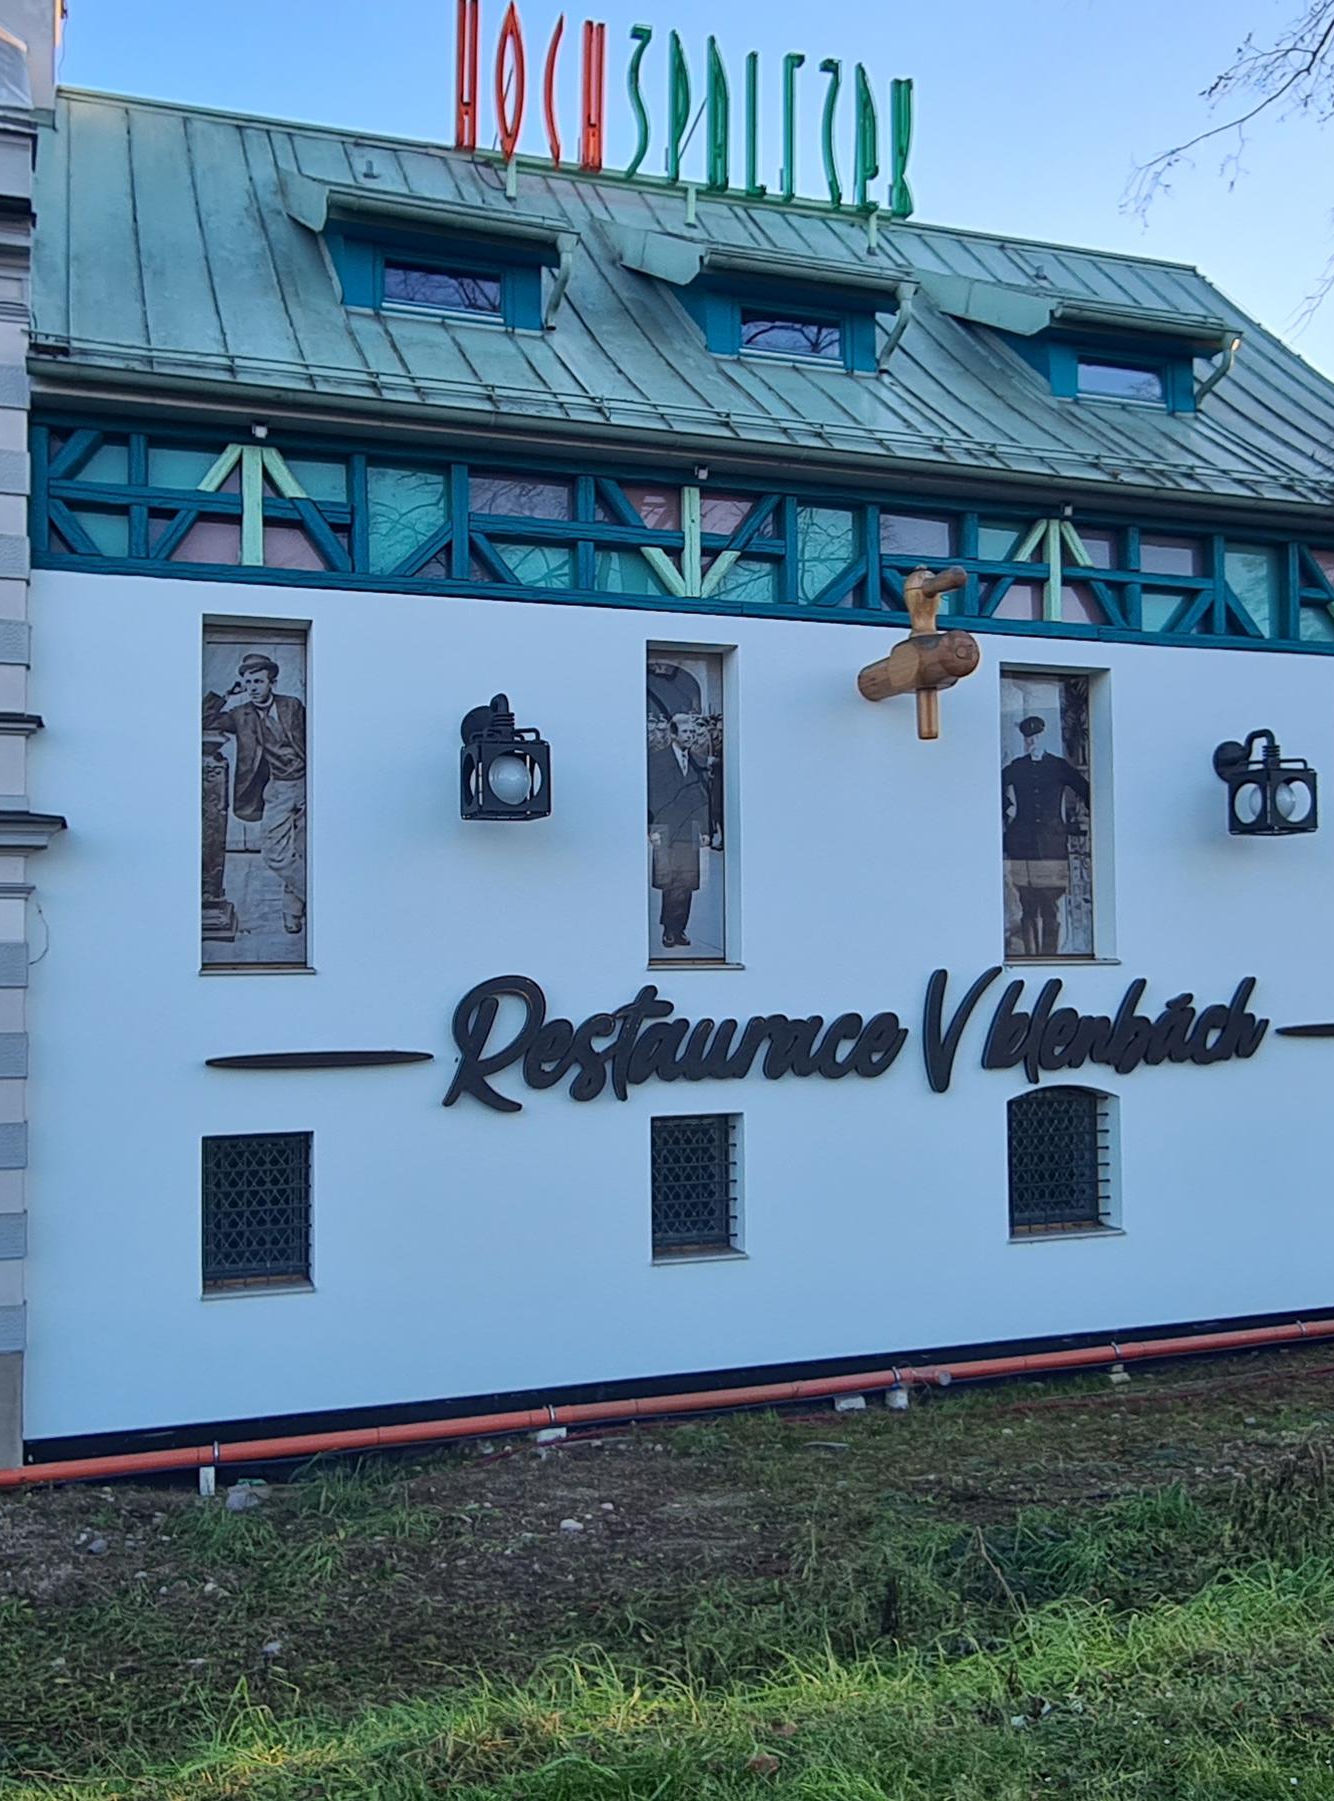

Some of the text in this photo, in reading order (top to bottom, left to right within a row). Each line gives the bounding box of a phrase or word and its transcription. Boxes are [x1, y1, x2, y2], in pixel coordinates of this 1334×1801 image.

[442, 966, 1270, 1113] Restaurace V klenbách
